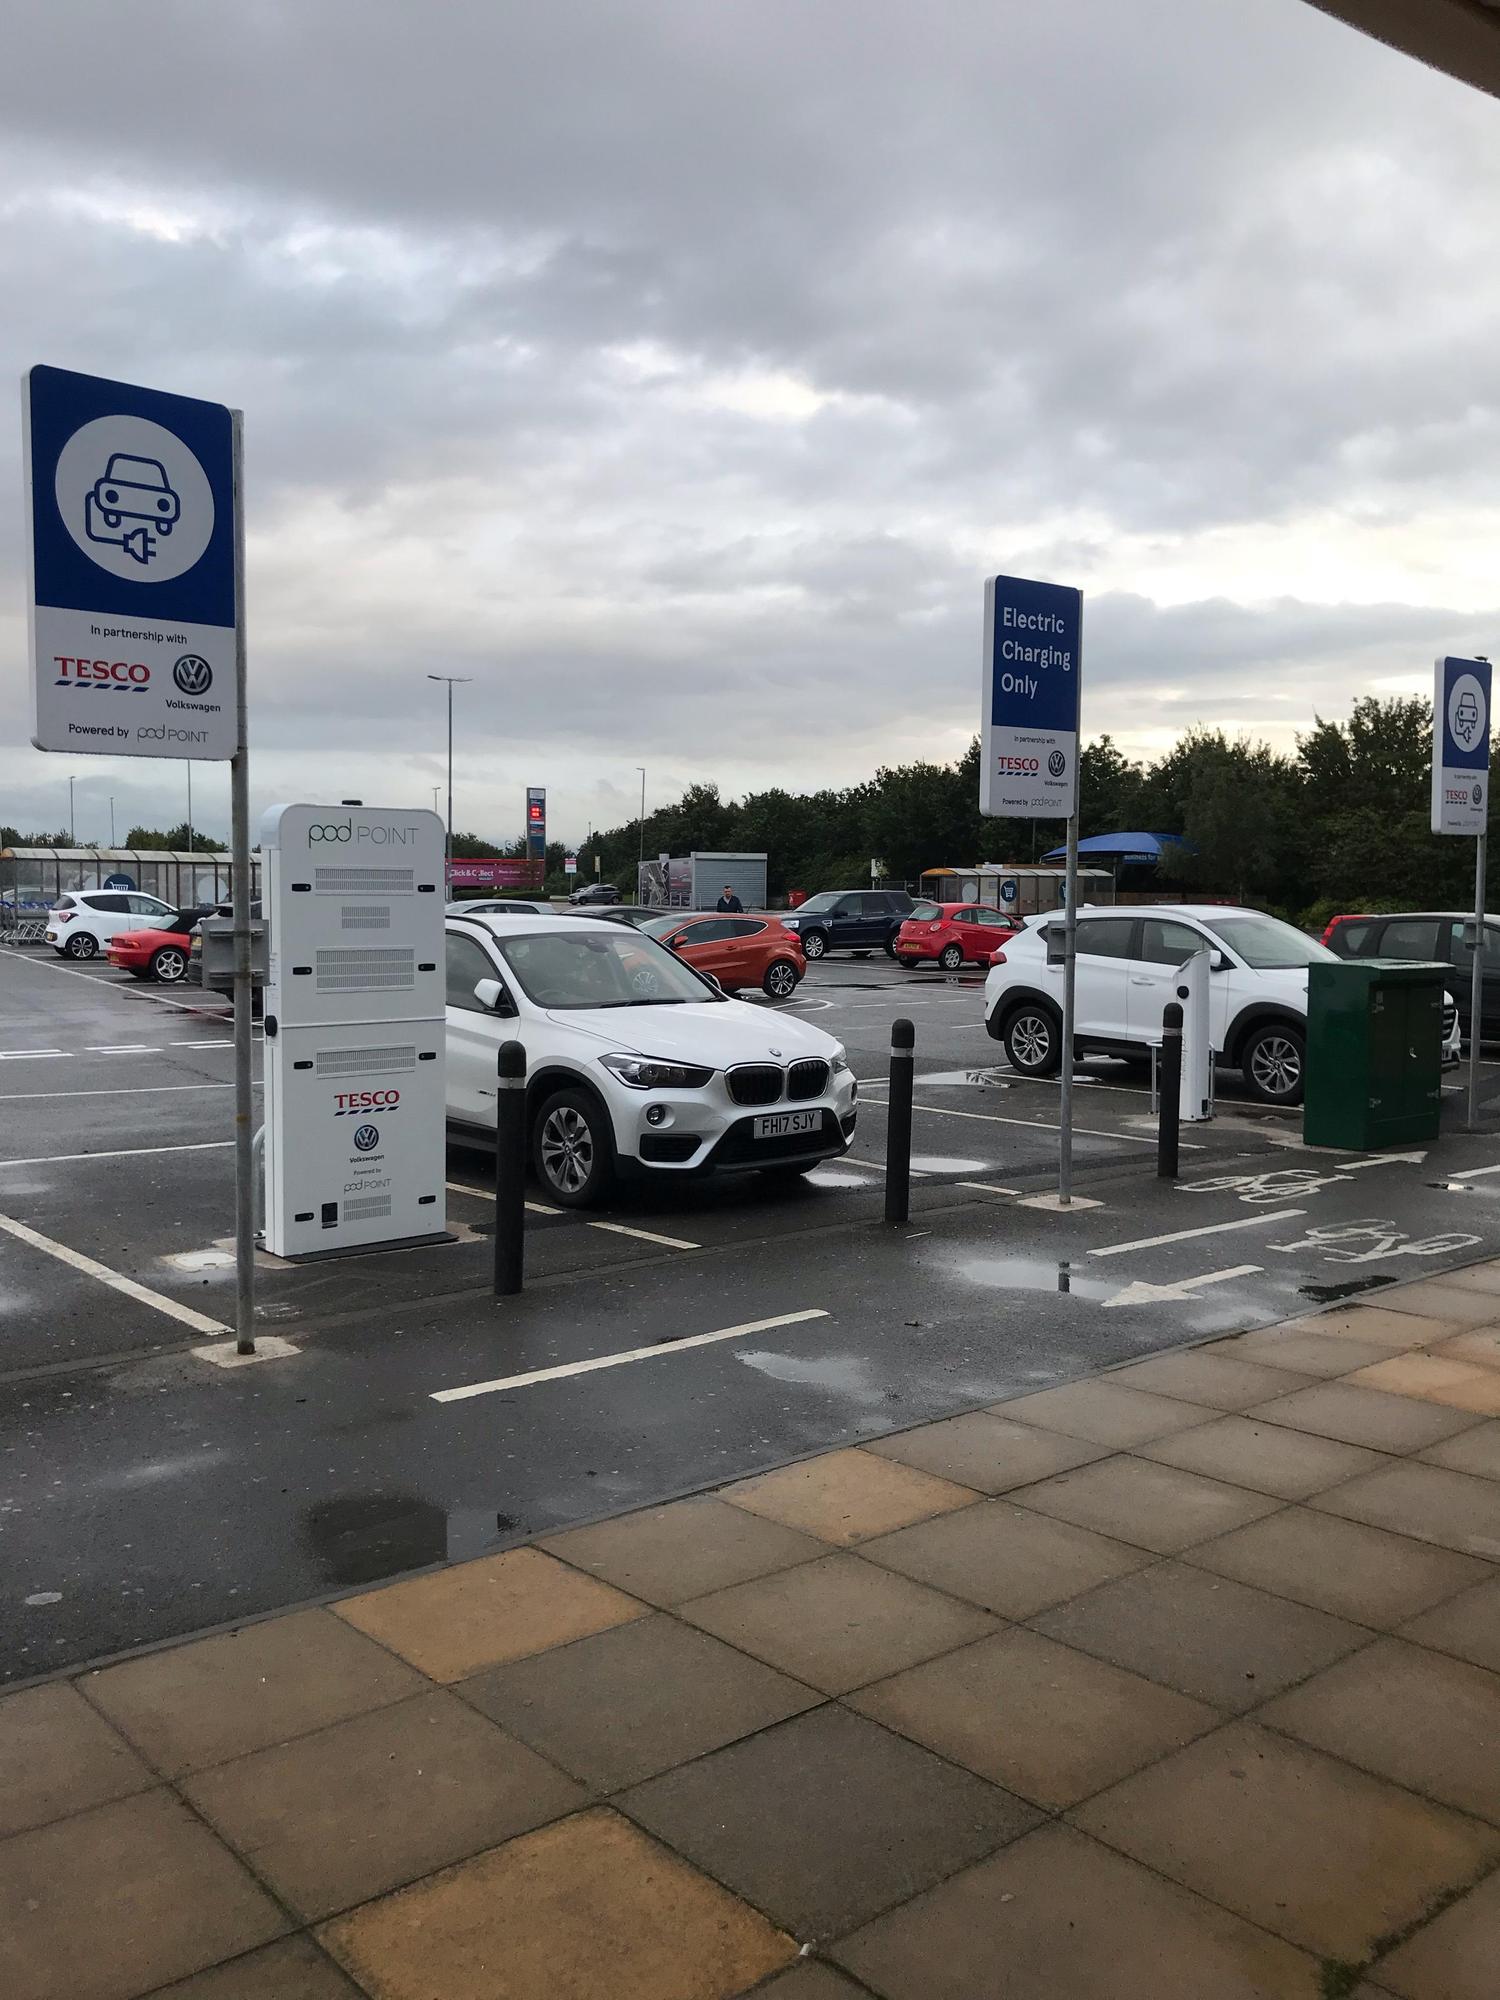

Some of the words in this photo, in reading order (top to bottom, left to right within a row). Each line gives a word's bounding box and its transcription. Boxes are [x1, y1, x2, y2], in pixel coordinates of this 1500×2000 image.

[1003, 606, 1064, 634] Electric
[91, 624, 100, 635] In
[103, 628, 164, 643] partnership
[166, 633, 188, 644] with
[1002, 640, 1071, 672] Charging
[54, 656, 150, 684] TESCO
[1001, 672, 1038, 700] Only
[166, 699, 221, 713] Volkswagen
[68, 723, 114, 736] Powered
[116, 726, 130, 739] by
[136, 724, 166, 743] pod
[168, 728, 209, 743] POINT
[1020, 736, 1046, 744] partnership
[998, 756, 1039, 770] TESCO
[1002, 798, 1022, 806] Powered
[1445, 790, 1468, 800] TESCO
[308, 818, 352, 848] pod
[357, 826, 420, 845] POINT
[334, 1090, 400, 1108] TESCO
[762, 1117, 789, 1135] FH17
[792, 1113, 815, 1130] SJY
[350, 1154, 384, 1163] Volkswagen
[364, 1178, 392, 1189] POINT
